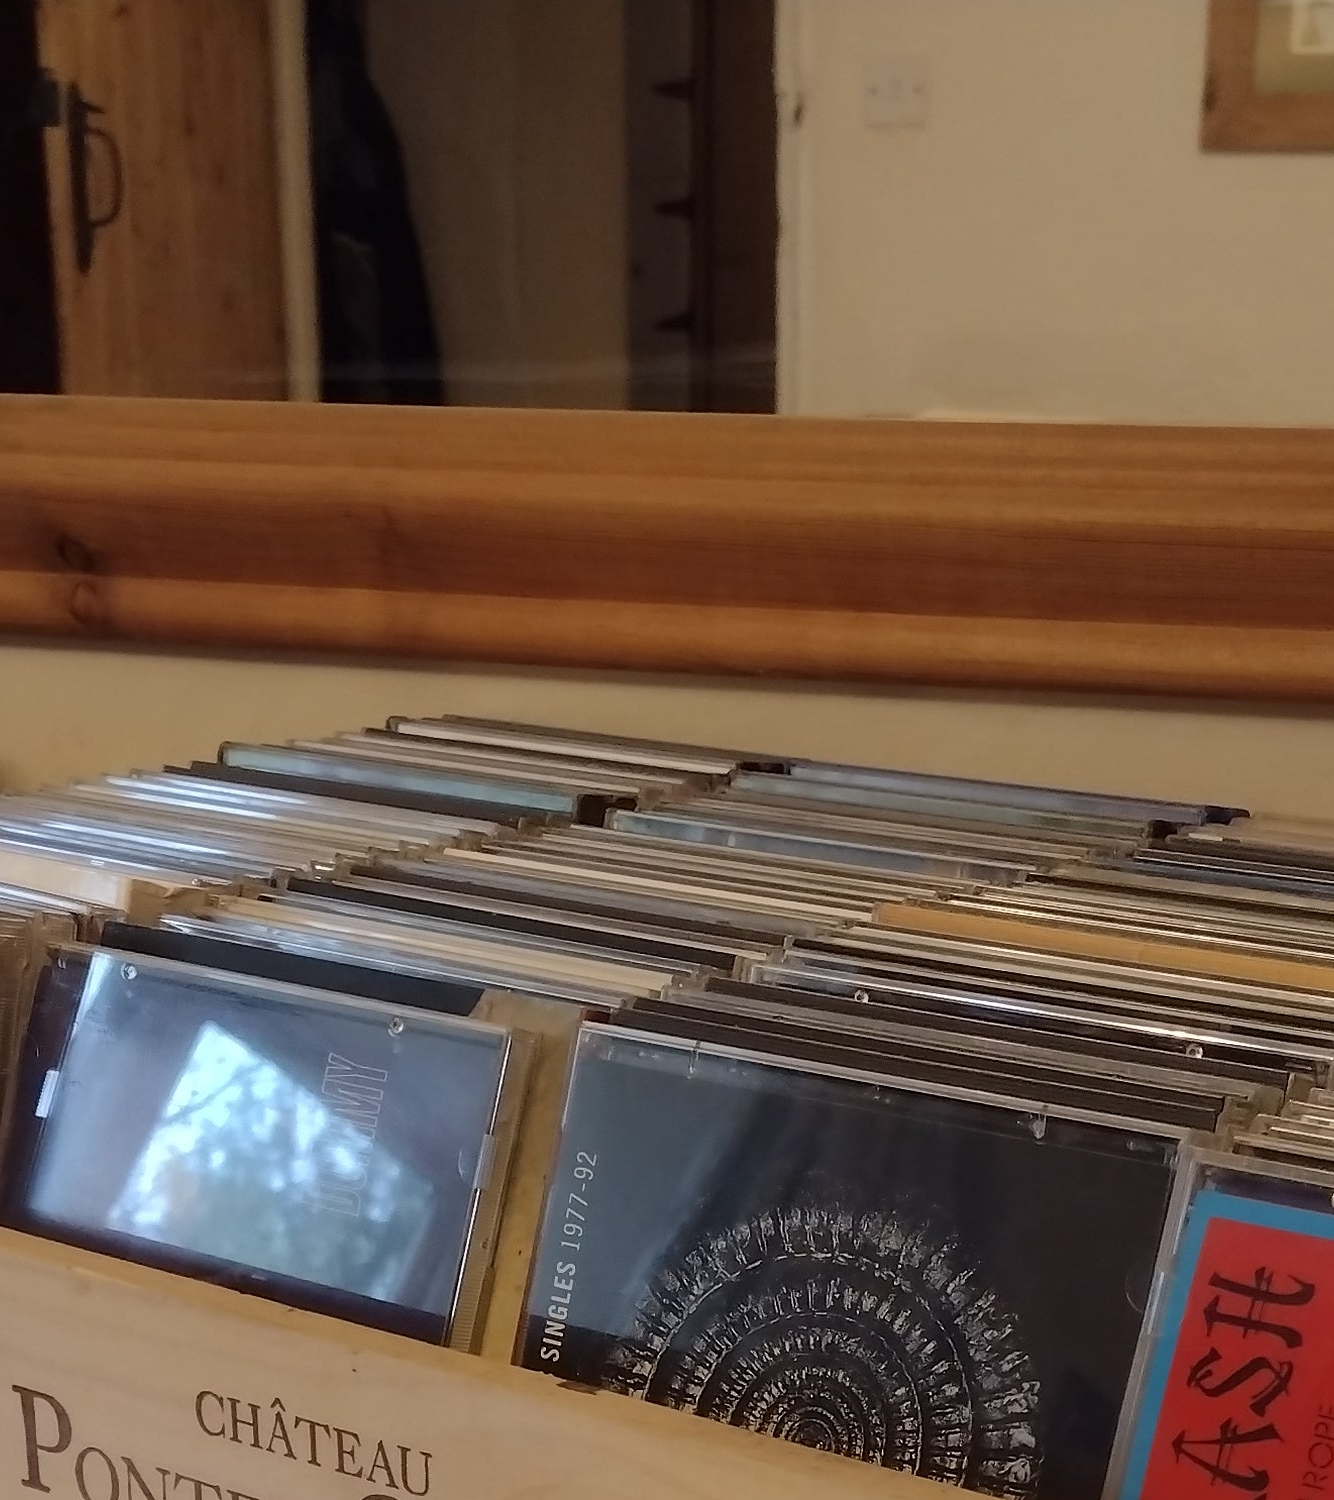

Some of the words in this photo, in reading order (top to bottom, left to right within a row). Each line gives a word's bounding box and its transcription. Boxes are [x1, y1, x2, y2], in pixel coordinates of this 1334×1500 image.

[557, 1149, 599, 1254] 1977-92
[540, 1260, 578, 1362] SINGLES
[194, 1389, 434, 1497] CHÂTEAU
